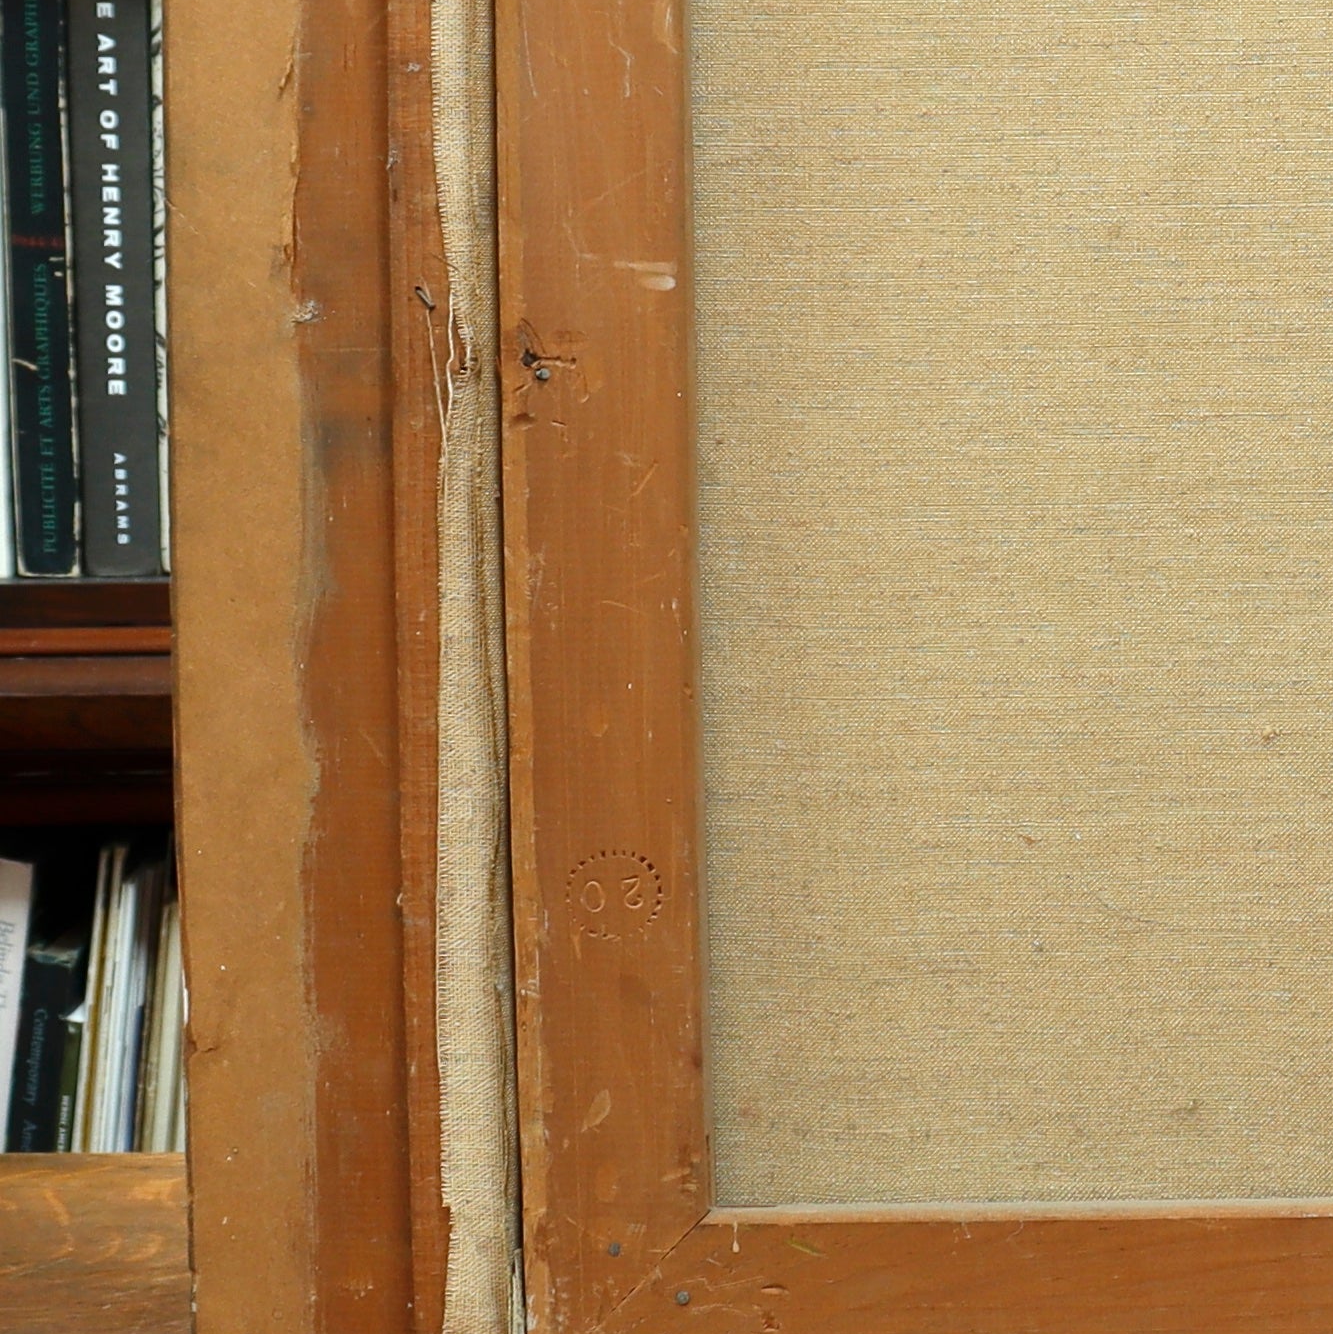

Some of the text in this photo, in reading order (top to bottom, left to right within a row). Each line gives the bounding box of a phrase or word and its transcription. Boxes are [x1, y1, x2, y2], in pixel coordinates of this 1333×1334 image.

[24, 71, 41, 115] UND
[97, 32, 118, 96] ART
[26, 122, 46, 217] WERBUNG
[99, 109, 120, 151] OF
[101, 163, 124, 270] HENRY
[32, 262, 52, 381] GRAPHIQUES
[104, 283, 128, 397] MOORE
[37, 384, 53, 429] ARTS
[112, 451, 132, 546] ABRAMS
[23, 1008, 49, 1106] Contemporary
